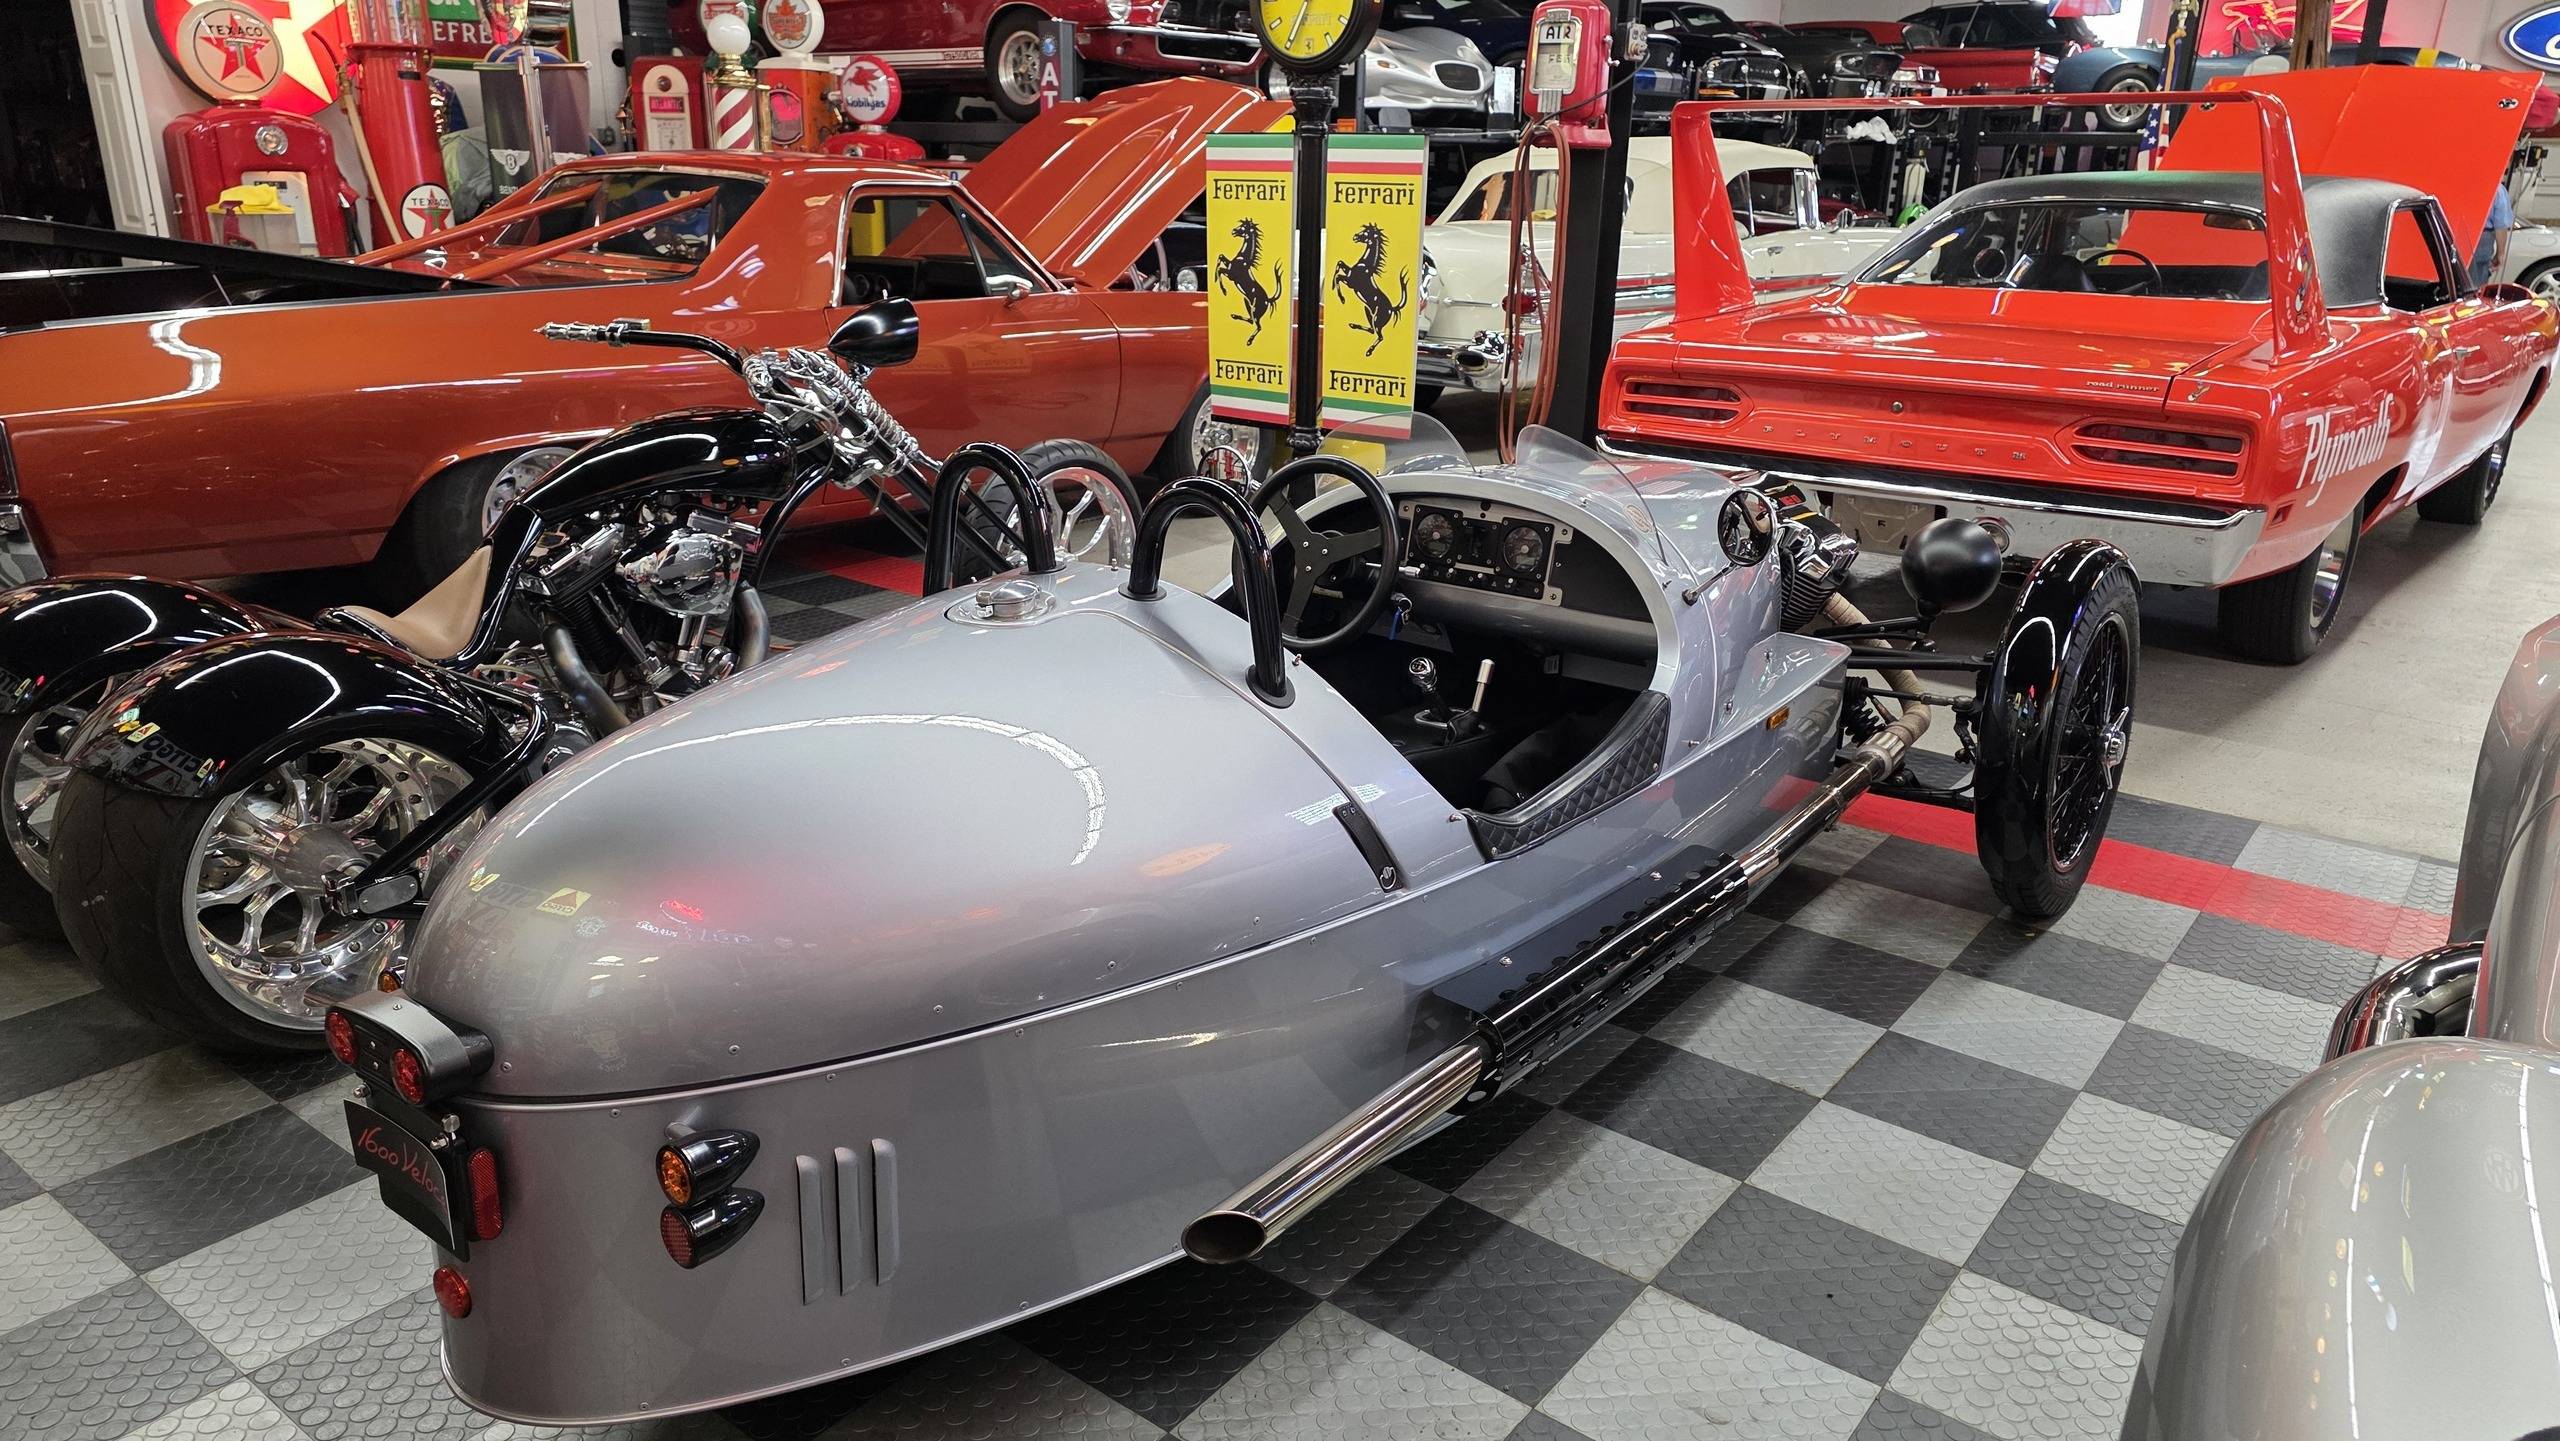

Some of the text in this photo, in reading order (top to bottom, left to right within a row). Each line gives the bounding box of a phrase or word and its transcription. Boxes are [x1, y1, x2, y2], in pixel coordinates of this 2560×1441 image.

[208, 25, 263, 37] TEXACO
[1546, 26, 1571, 39] AIR
[1213, 179, 1286, 201] Ferrari
[1333, 182, 1415, 205] Ferrari
[1215, 359, 1283, 385] Ferrari
[1329, 369, 1406, 398] Ferrari
[2117, 384, 2160, 392] runner
[2296, 393, 2393, 508] Plymouth
[358, 1127, 398, 1166] 1600
